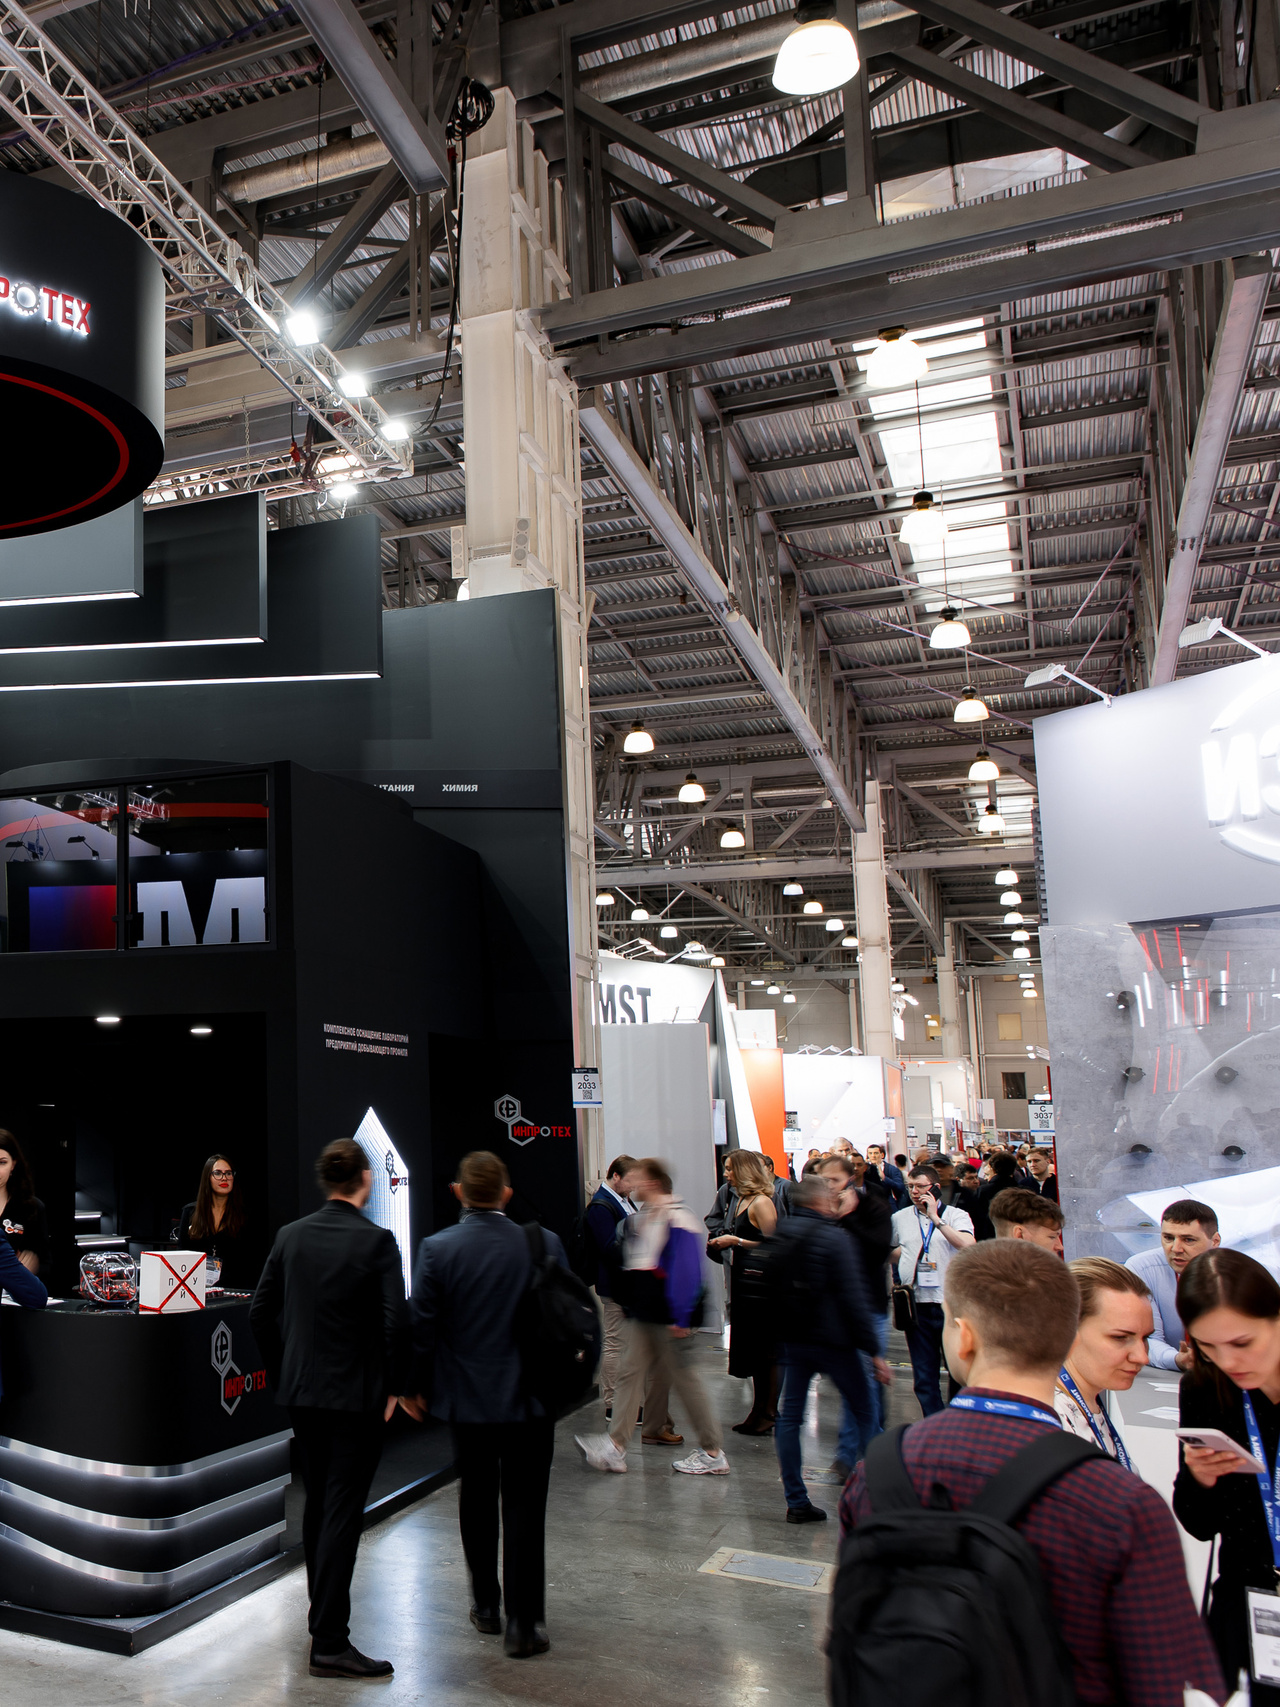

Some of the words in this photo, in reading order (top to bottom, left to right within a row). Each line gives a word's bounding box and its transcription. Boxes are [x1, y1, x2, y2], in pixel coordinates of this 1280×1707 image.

[442, 784, 478, 792] ХИМИЯ
[583, 1074, 590, 1082] C
[577, 1082, 596, 1090] 2033
[1033, 1112, 1053, 1120] 3037
